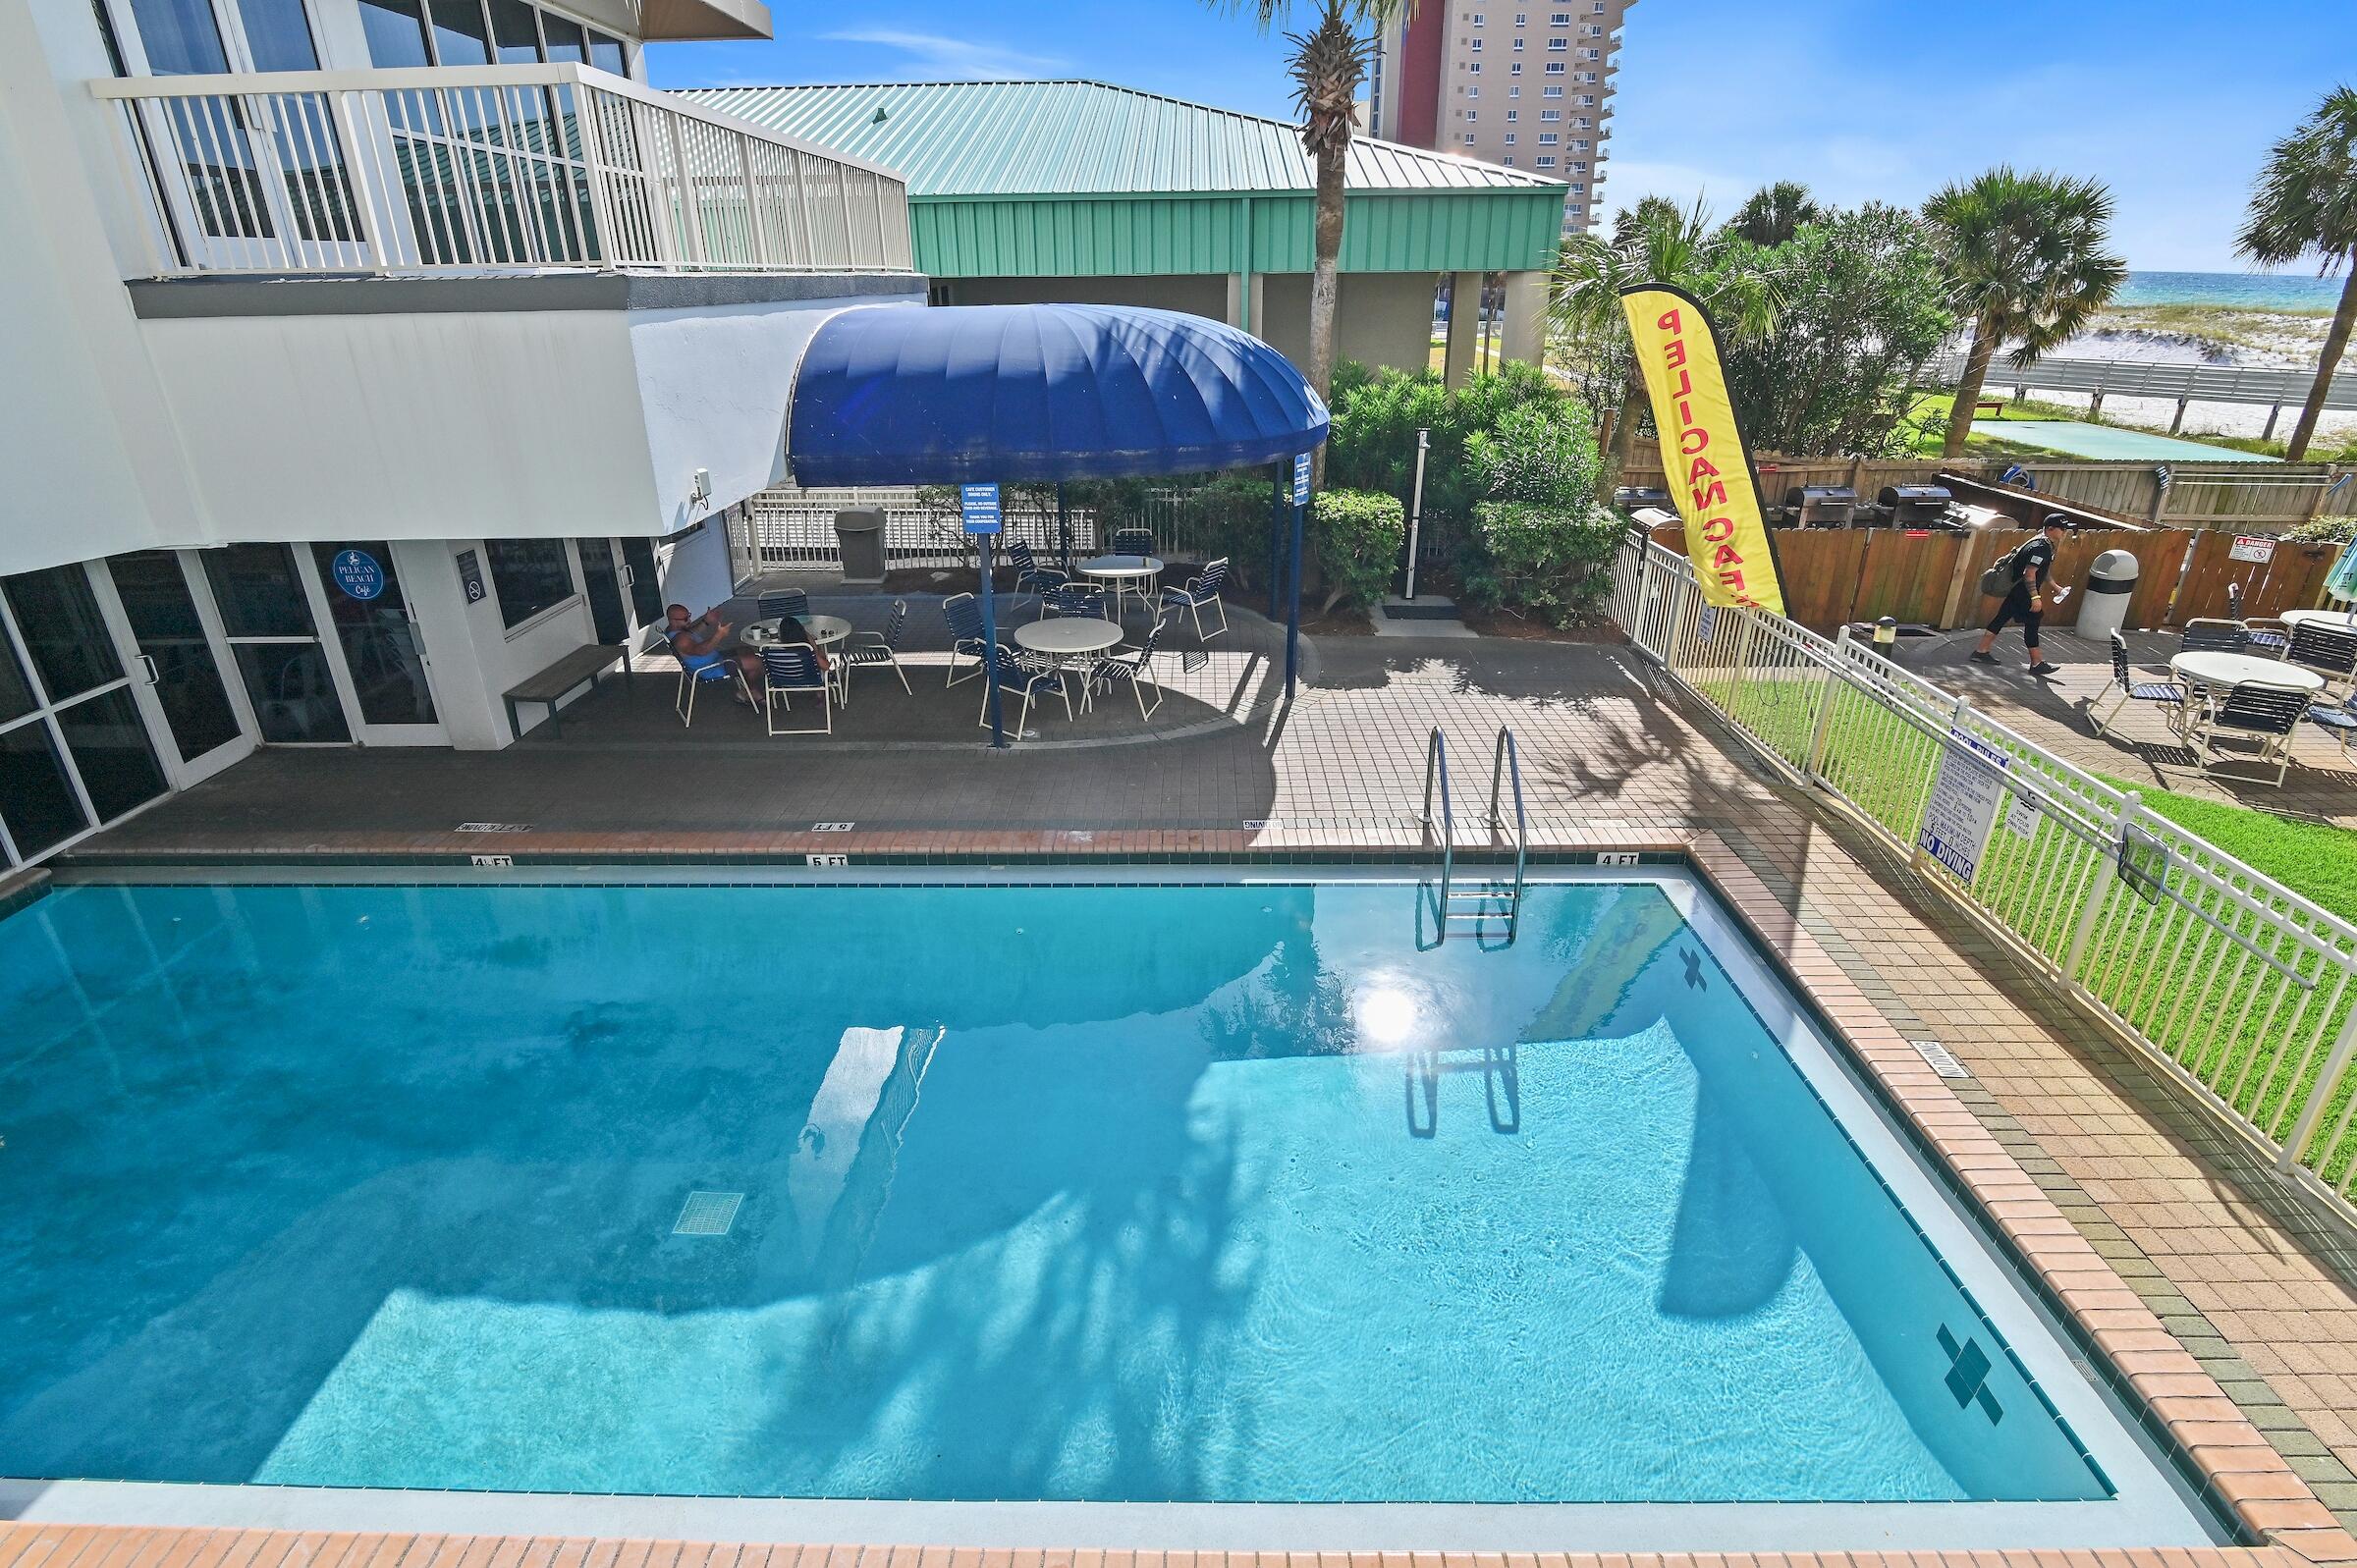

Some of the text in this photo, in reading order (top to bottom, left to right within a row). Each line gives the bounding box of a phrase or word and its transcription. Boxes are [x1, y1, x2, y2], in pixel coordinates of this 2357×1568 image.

[2246, 539, 2273, 548] DANGER
[339, 566, 375, 574] PELICAN
[345, 574, 374, 583] BEACH
[356, 585, 371, 597] Café
[1976, 744, 2002, 766] RULES
[2015, 808, 2028, 820] SWIM
[2006, 817, 2029, 837] OWN RISK
[2016, 817, 2029, 829] YOUR
[493, 857, 510, 866] FT
[812, 856, 846, 866] 5 FT
[1602, 855, 1637, 864] 4 FT
[1920, 830, 1972, 882] NO DIVING
[1915, 1042, 1964, 1077] NO DIVING
